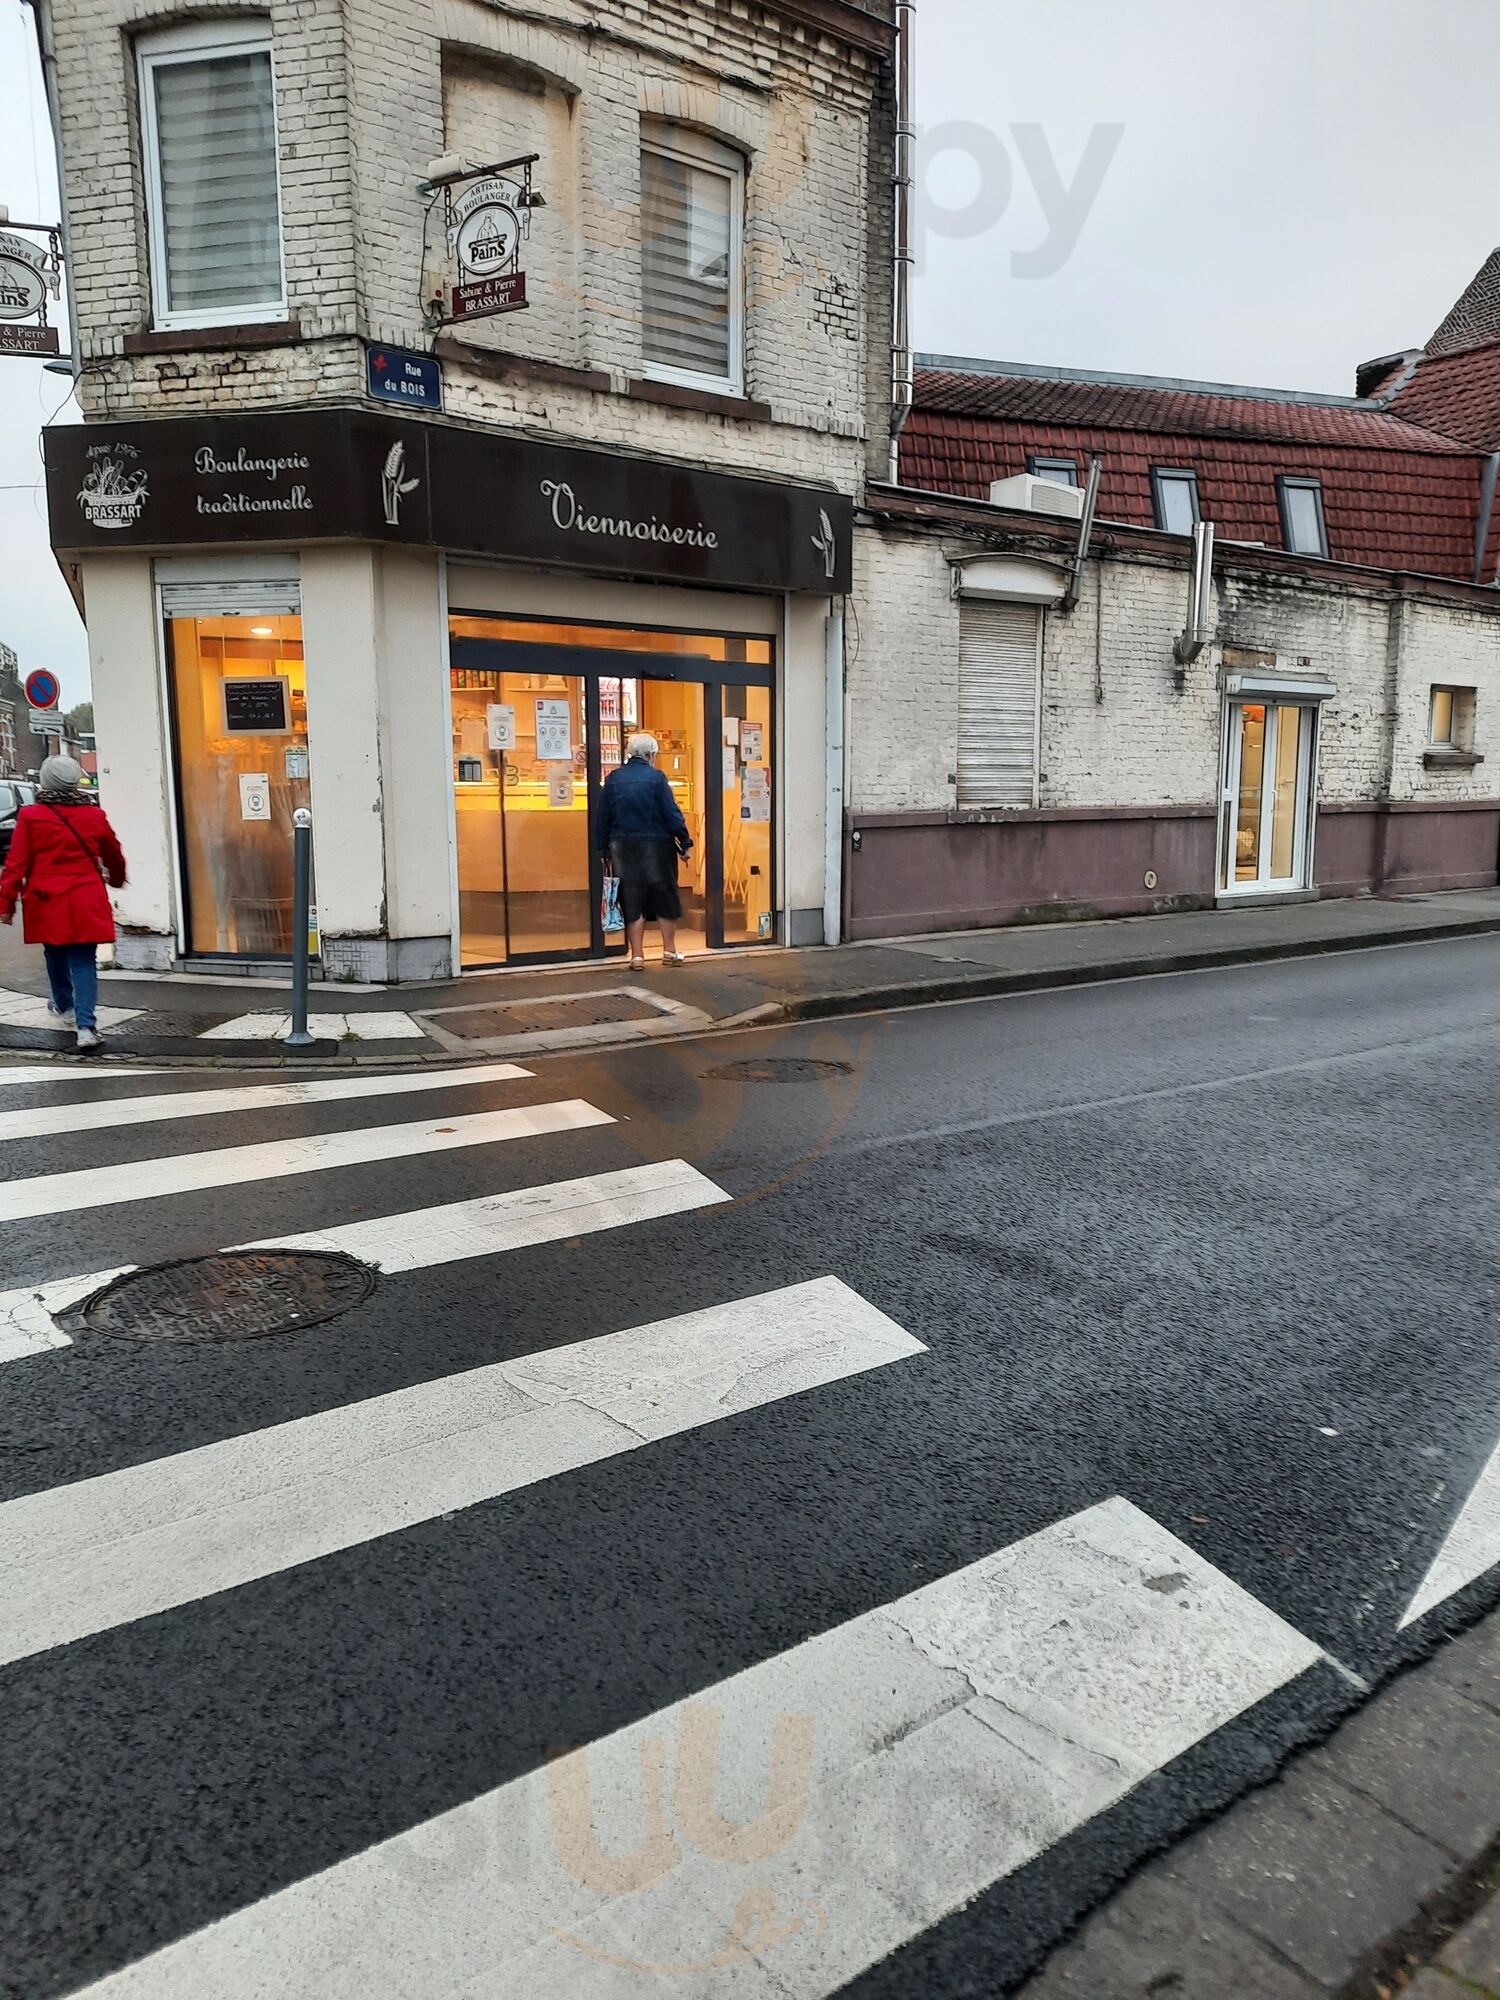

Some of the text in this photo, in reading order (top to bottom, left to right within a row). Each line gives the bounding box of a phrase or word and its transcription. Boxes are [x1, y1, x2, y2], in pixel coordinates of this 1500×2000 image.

[469, 181, 505, 197] ARTISAN
[463, 191, 511, 213] BOULANGER
[459, 278, 517, 300] Sabine & Pierre
[465, 292, 511, 312] BRASSART
[17, 327, 46, 339] Pierre
[405, 362, 422, 377] Rue
[384, 378, 425, 397] du BOIS
[194, 446, 311, 481] Boulangerie
[196, 485, 313, 515] traditionnelle
[85, 504, 143, 520] BRASSART
[539, 478, 719, 549] Viennoiserie
